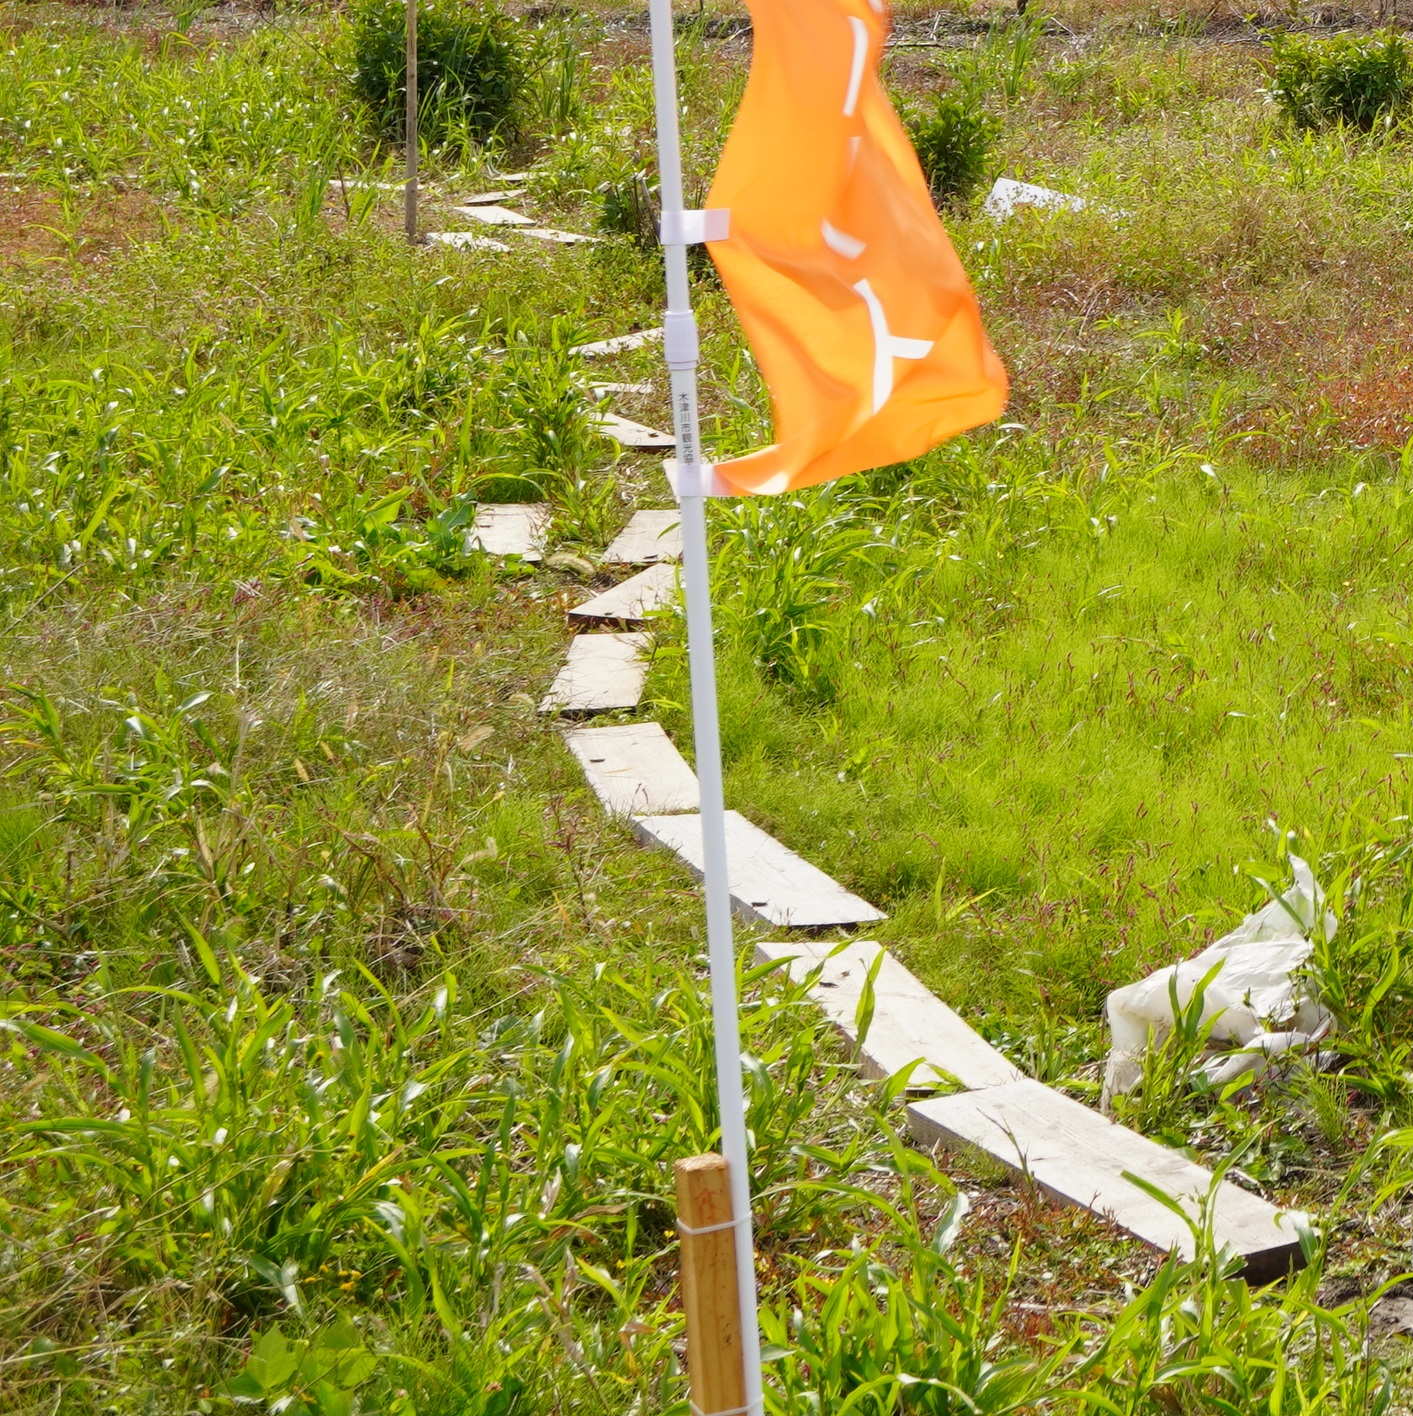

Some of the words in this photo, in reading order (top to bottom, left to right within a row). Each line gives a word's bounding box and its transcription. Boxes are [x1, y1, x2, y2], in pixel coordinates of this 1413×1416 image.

[678, 393, 694, 470] 木津川市観光協
